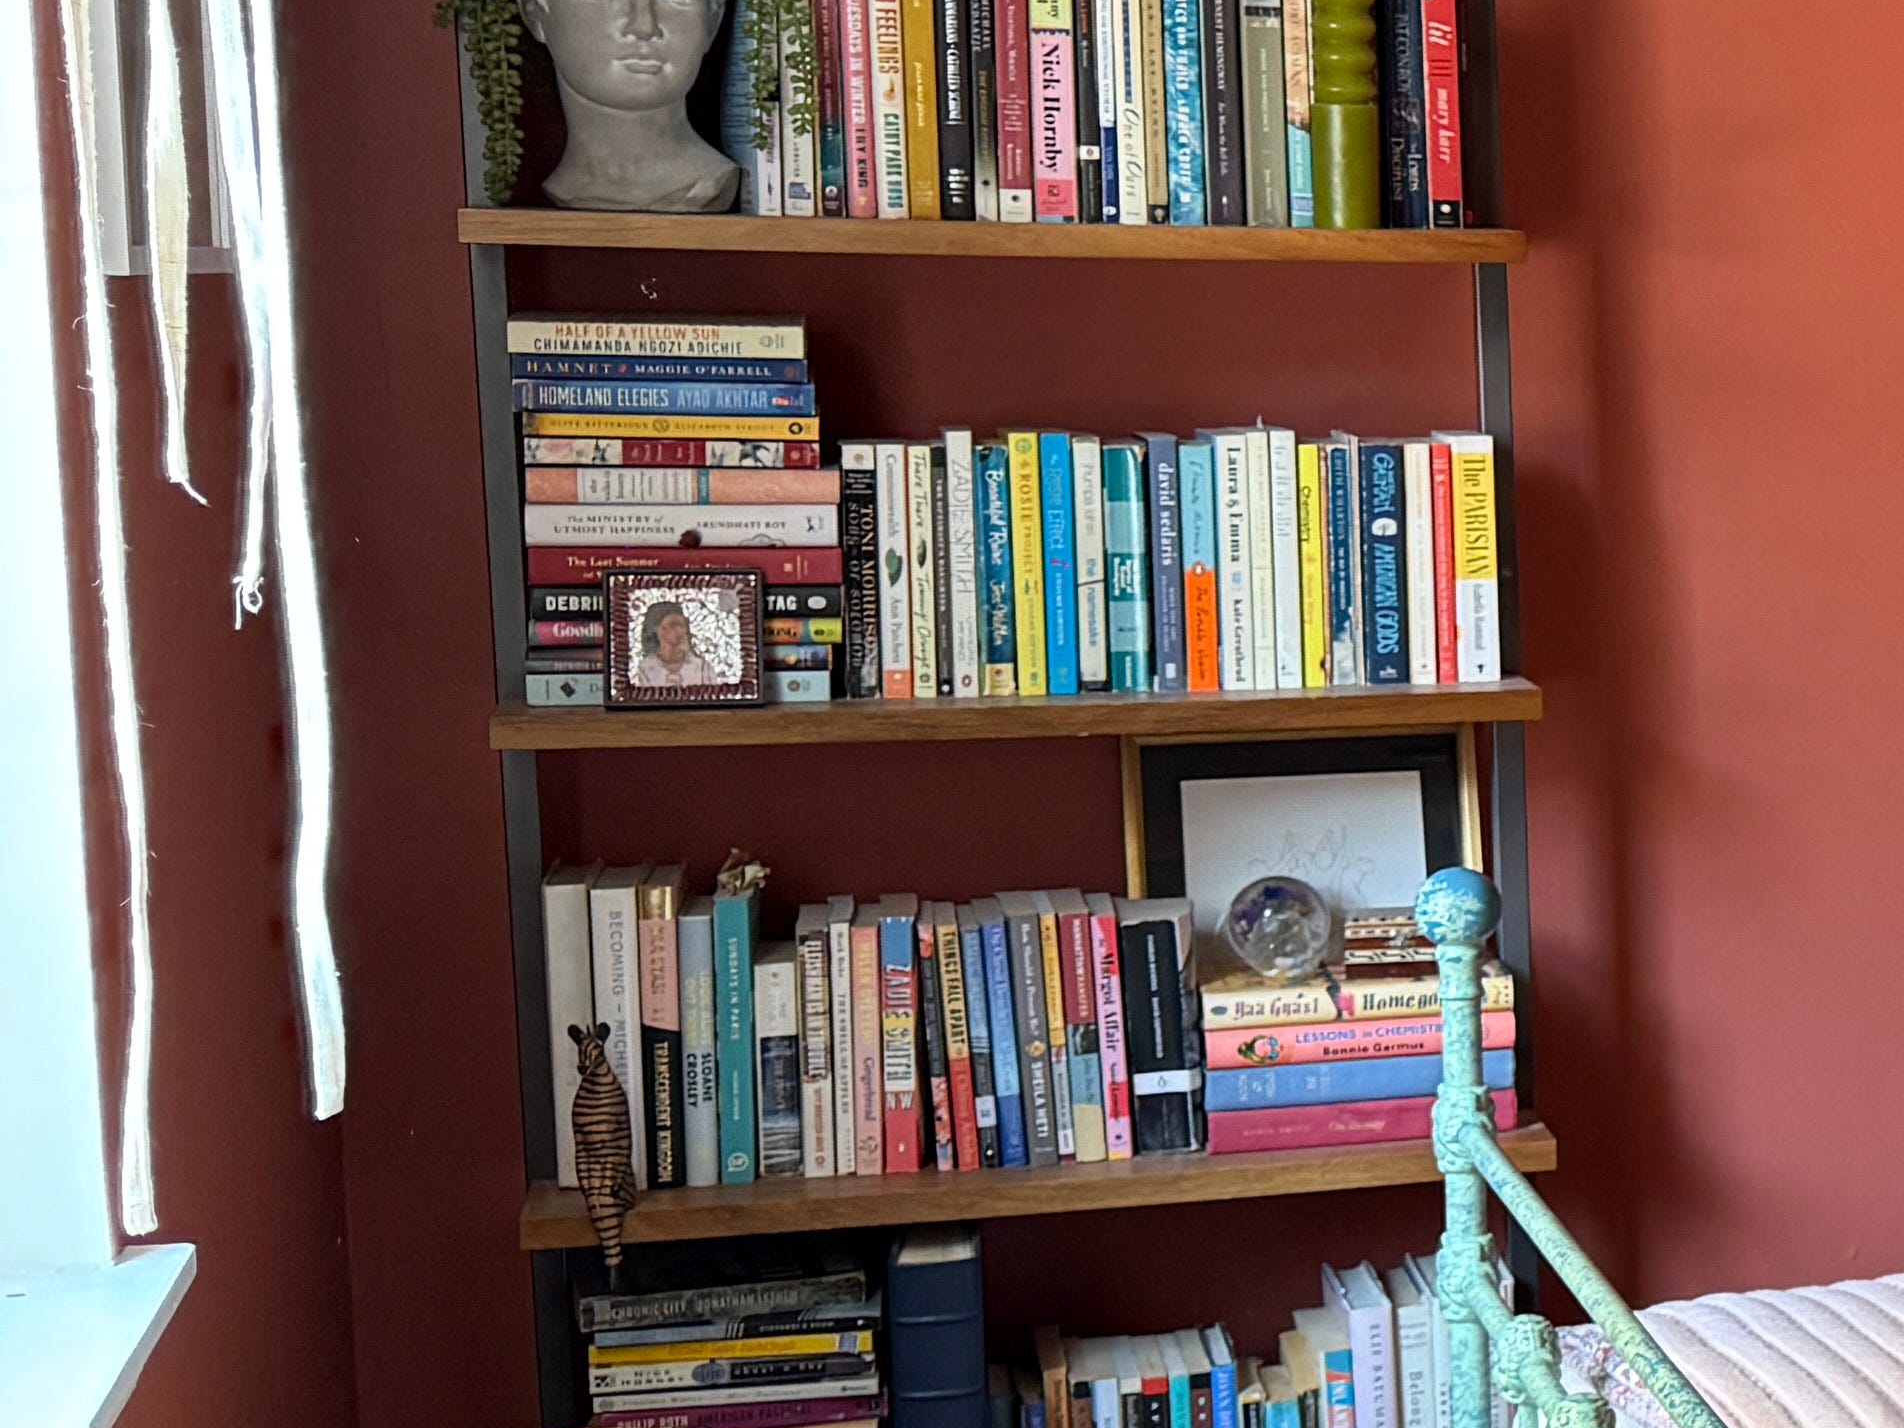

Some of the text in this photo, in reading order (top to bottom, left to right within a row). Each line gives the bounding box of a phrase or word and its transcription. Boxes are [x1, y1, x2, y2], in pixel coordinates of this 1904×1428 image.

[849, 57, 863, 71] IN
[876, 8, 900, 74] FEELINGS
[1214, 32, 1225, 91] HEMINGWAY
[850, 75, 866, 124] WINTER
[1041, 41, 1063, 174] Nick Hornby
[884, 113, 901, 146] CATHY
[1432, 88, 1455, 164] mary karr
[857, 158, 868, 188] KING
[885, 149, 902, 177] PARK
[888, 180, 904, 209] HONG
[534, 337, 743, 355] CHIMAMANDA NGOZI ADICHIE
[555, 325, 720, 341] HALF OF A YELLOW SUN
[527, 360, 772, 376] HAMNET MAGGIE O'FARRELL
[539, 385, 769, 408] HOMELAND ELEGIES AYAD AKHTAR
[951, 459, 971, 524] ZADIE
[1227, 447, 1243, 494] Laura
[1158, 463, 1177, 566] david sedaris
[1229, 512, 1245, 562] Emma
[1463, 457, 1491, 576] The PARISIAN
[861, 505, 876, 661] TONI MORRISON
[953, 529, 973, 594] SMITH
[1233, 598, 1244, 623] Kate
[1375, 610, 1399, 654] GODS
[1234, 626, 1246, 682] Greathead
[609, 910, 626, 996] BECOMING
[729, 937, 740, 1040] SUNDAYS IN PARIS
[943, 932, 965, 1045] THINGS FALL APART
[886, 966, 913, 1081] ZADIE SMITH
[1295, 1029, 1372, 1044] LESSONS in
[1323, 1042, 1425, 1056] Bonnie Garmus
[686, 1053, 698, 1108] CROSLEY
[701, 1053, 712, 1103] SLOANE
[1031, 1061, 1048, 1138] SHEILA HETI
[1370, 1324, 1382, 1356] ELIF
[1408, 1371, 1424, 1426] Belong
